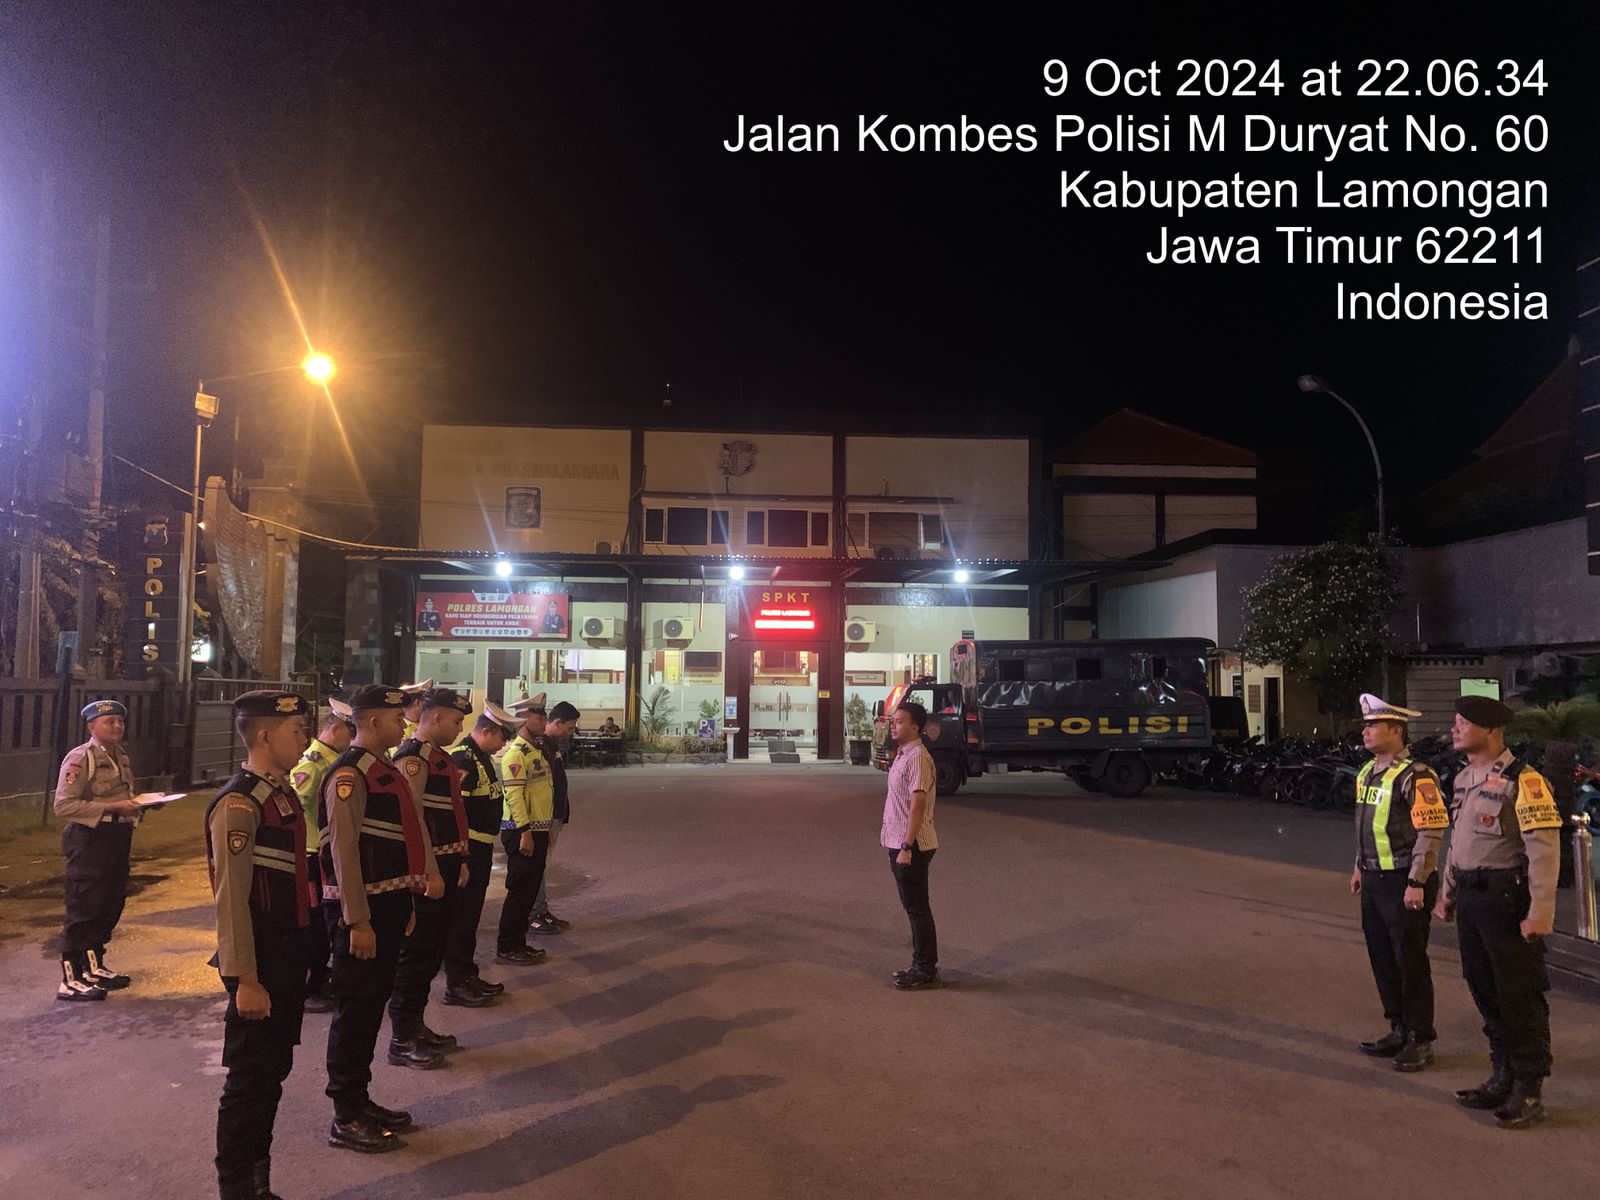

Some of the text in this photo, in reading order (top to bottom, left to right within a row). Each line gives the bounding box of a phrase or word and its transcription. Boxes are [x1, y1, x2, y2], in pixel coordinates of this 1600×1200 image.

[142, 557, 163, 672] POLIS
[447, 603, 483, 612] POLRES
[1027, 716, 1189, 736] POLISI
